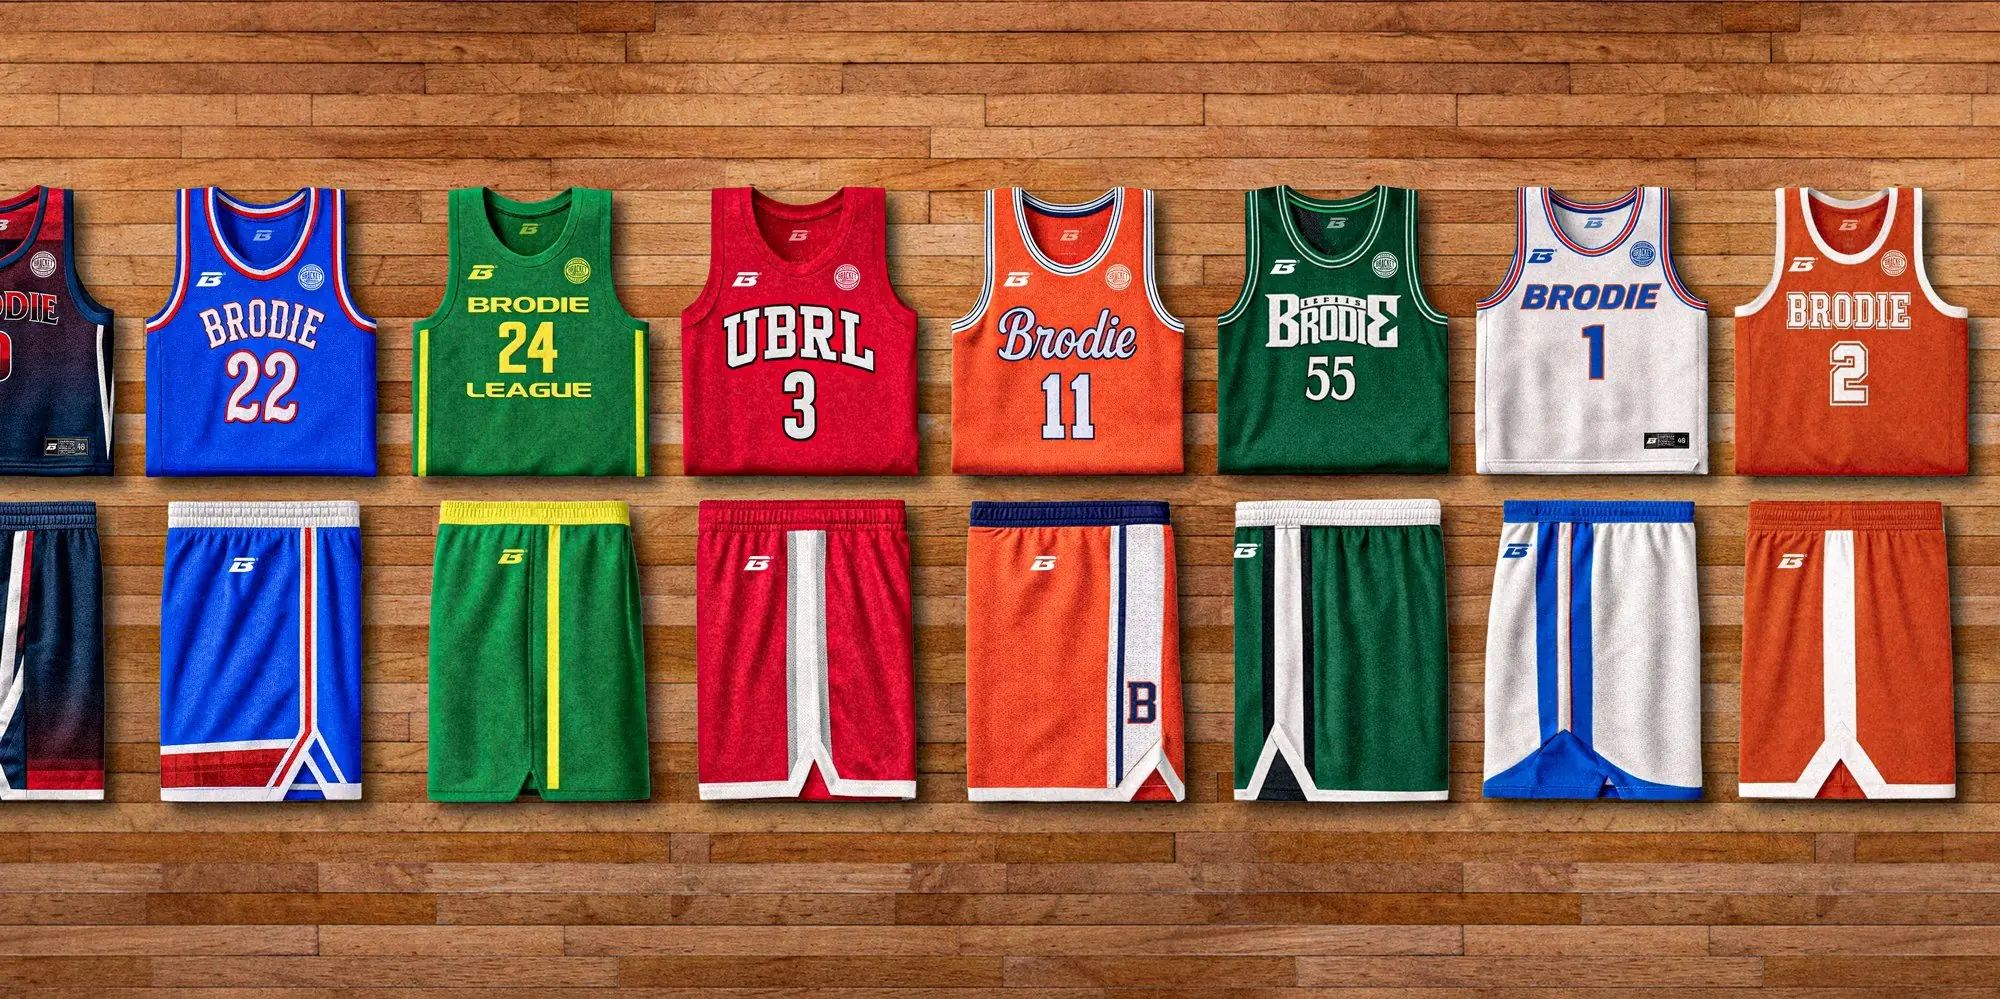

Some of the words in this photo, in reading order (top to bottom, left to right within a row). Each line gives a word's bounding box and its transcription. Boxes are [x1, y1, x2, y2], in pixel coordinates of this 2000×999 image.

[0, 290, 59, 326] DIE
[468, 297, 589, 313] BRODIE
[1265, 293, 1402, 348] BRODIE
[1520, 283, 1662, 310] BRODIE
[1786, 291, 1911, 330] BRODIE
[199, 299, 325, 350] BRODIE
[499, 321, 558, 374] 24
[723, 304, 876, 373] UBRL
[997, 306, 1137, 361] Brodie
[1305, 355, 1356, 401] 55
[1581, 323, 1605, 380] 1
[1829, 340, 1869, 407] 2
[224, 349, 298, 423] 22
[467, 382, 592, 398] LEAGUE
[782, 369, 817, 440] 3
[1041, 373, 1095, 440] 11
[1127, 680, 1157, 725] B
